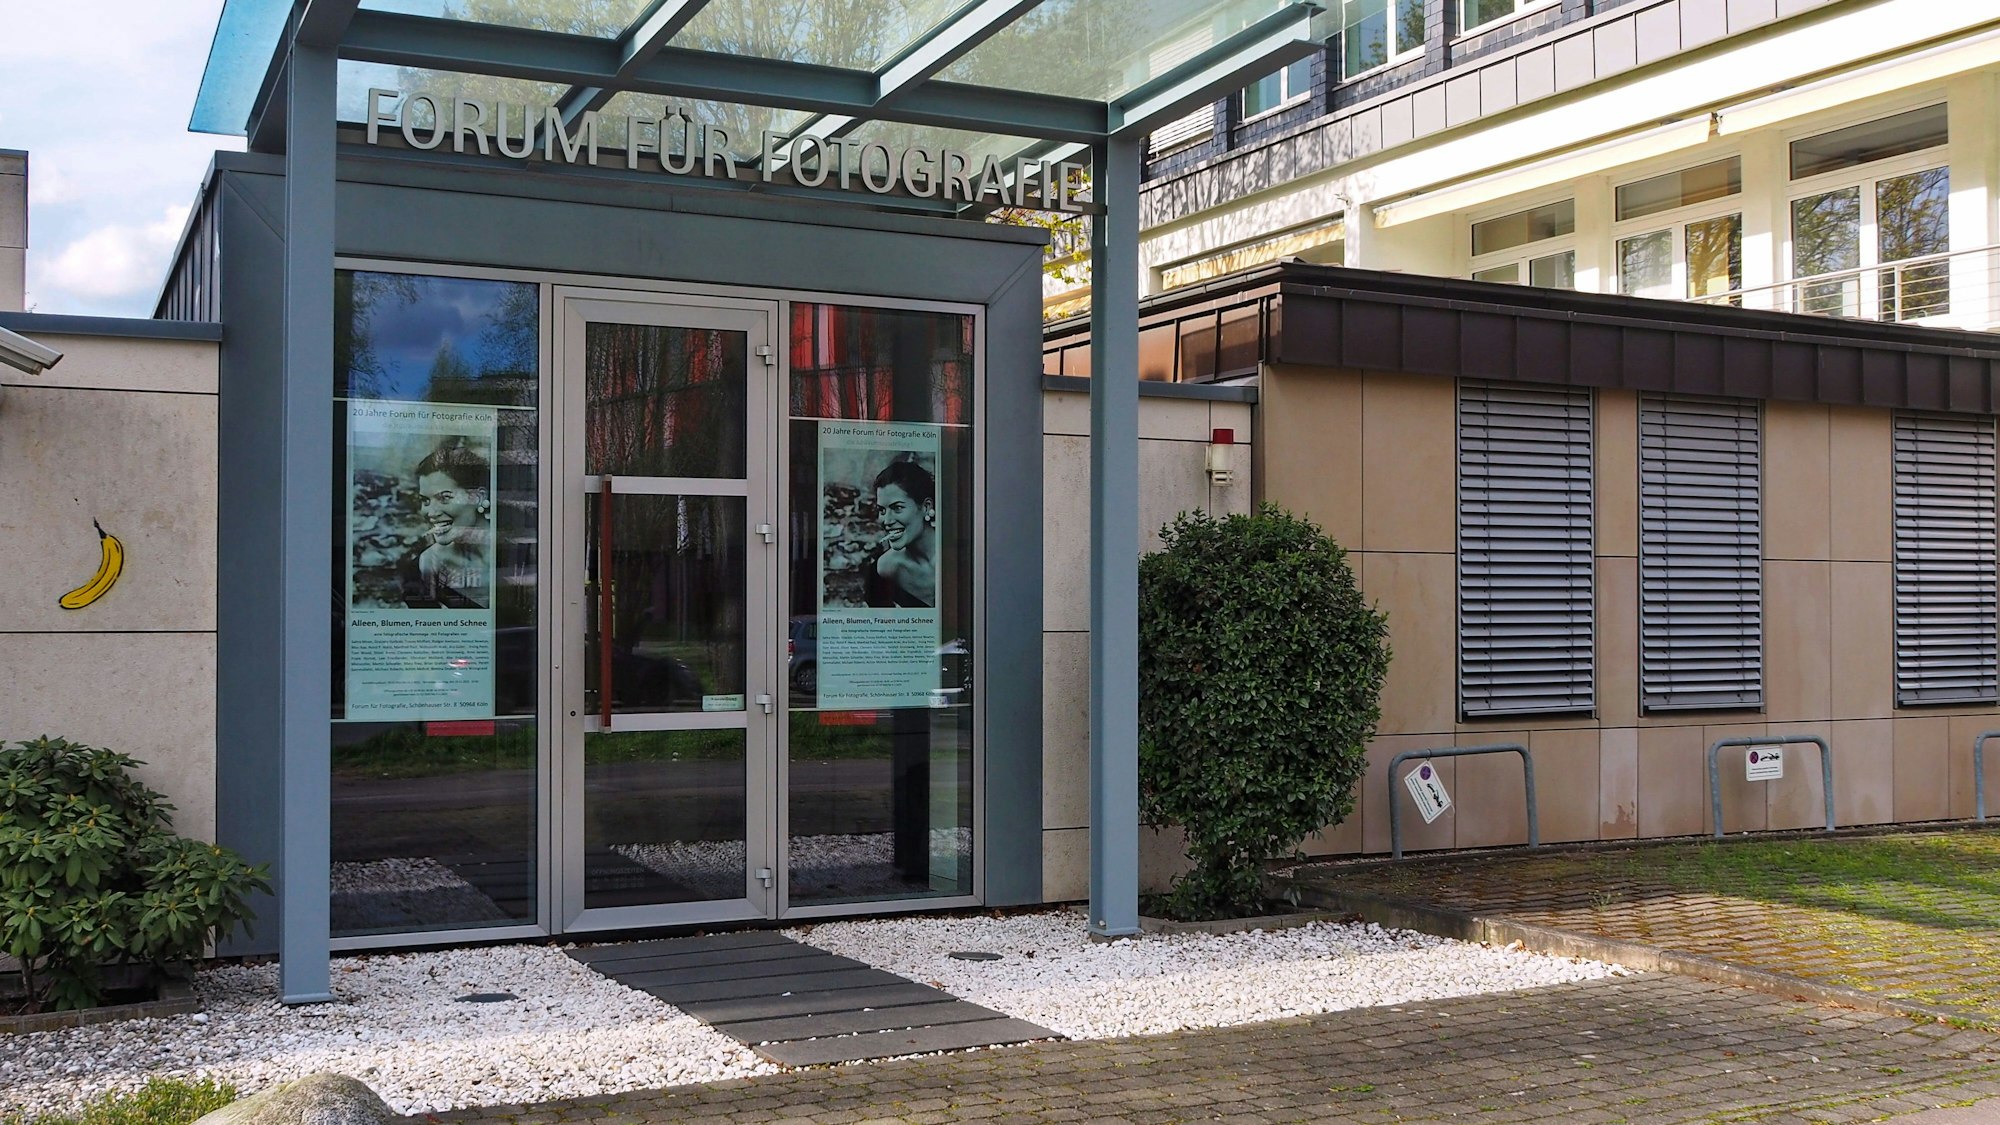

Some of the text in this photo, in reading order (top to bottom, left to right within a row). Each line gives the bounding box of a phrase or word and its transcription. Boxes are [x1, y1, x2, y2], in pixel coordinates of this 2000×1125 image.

[366, 87, 1086, 213] FORUM FÜR FOTOGRAFIE
[352, 408, 364, 417] 20
[364, 408, 387, 418] Jahre
[389, 409, 416, 419] Forum
[418, 410, 430, 420] für
[432, 411, 473, 422] Fotografie
[822, 426, 937, 439] 20 Jahre Forum für Fotografie Köln
[351, 619, 488, 628] Alleen, Blumen, Frauen und Schnee
[822, 617, 845, 625] Alleen,
[846, 617, 873, 625] Blumen,
